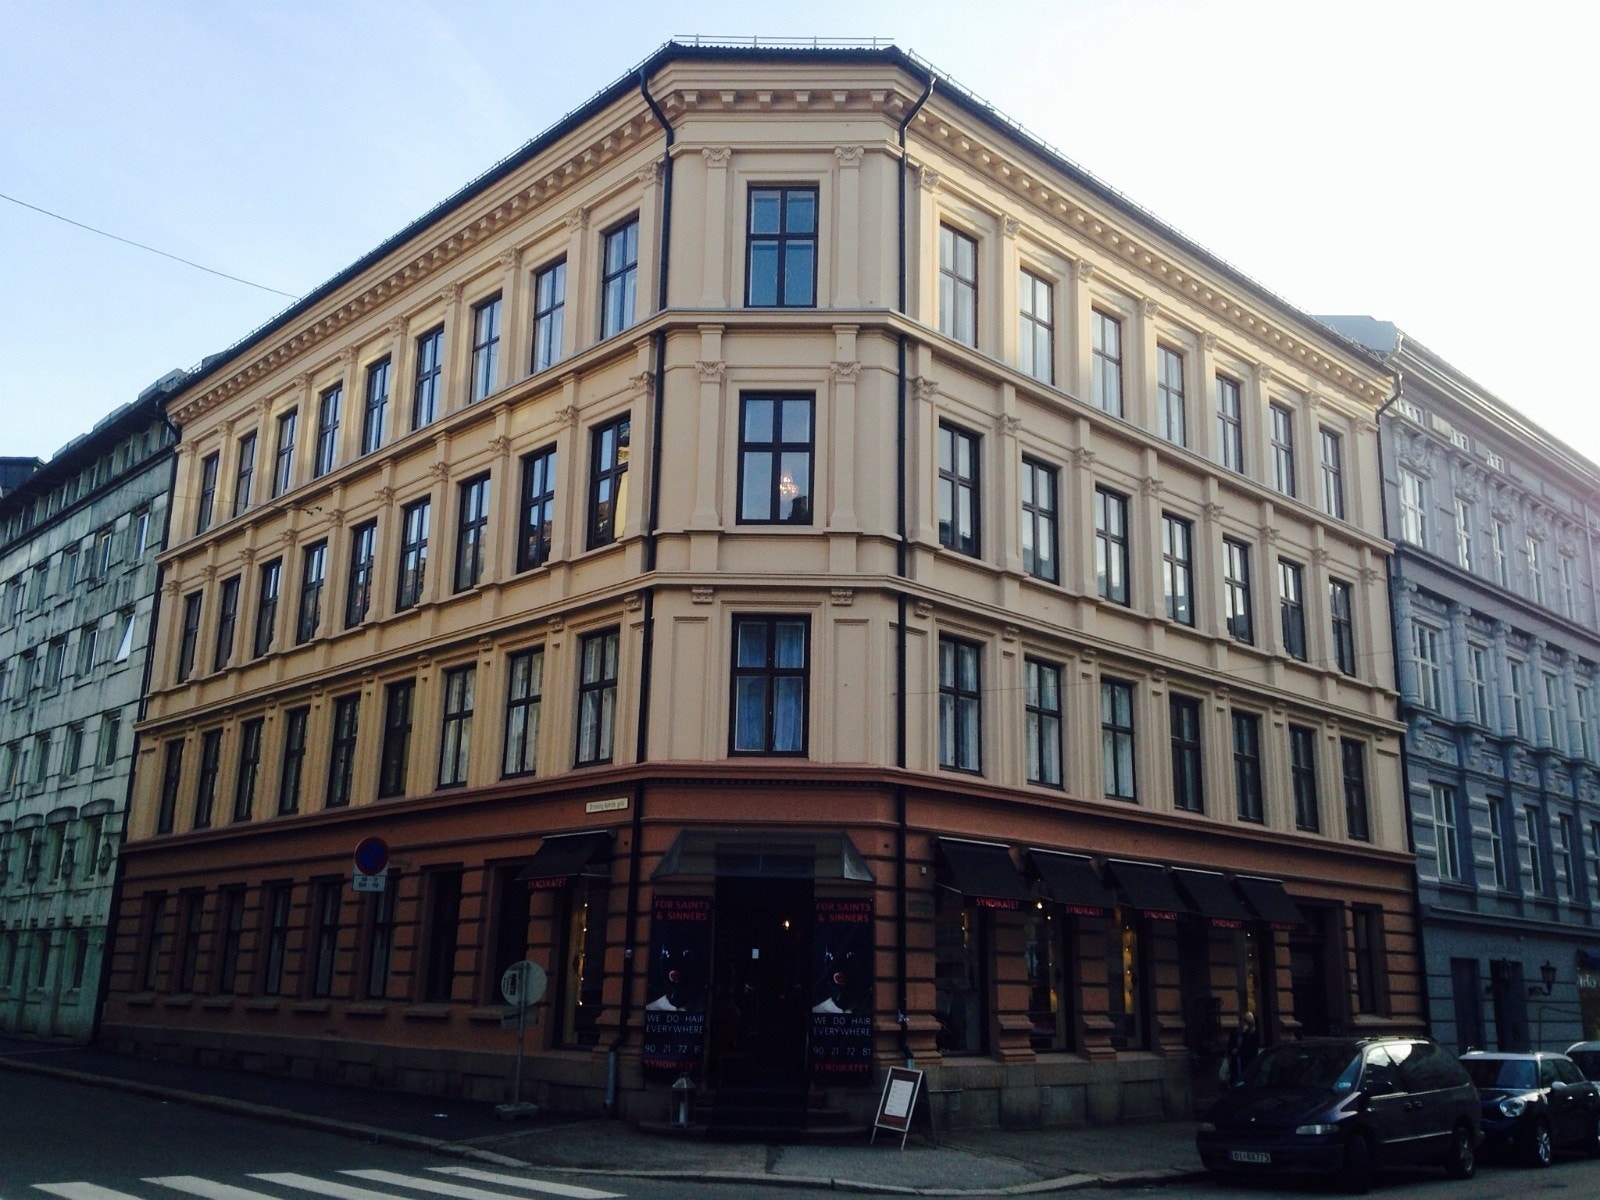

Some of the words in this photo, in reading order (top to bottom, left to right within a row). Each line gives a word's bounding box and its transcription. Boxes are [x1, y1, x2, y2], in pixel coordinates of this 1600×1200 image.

[527, 878, 567, 889] SYNDIKATET
[655, 900, 673, 909] FOR
[676, 901, 711, 910] SAINTS
[816, 902, 834, 911] FOR
[838, 902, 872, 912] SAINTS
[976, 897, 1020, 910] SYNDIKATET
[1065, 904, 1104, 917] SYNDIKATET
[656, 911, 663, 920] &
[667, 911, 708, 921] SINNERS
[817, 913, 825, 922] &
[829, 913, 870, 923] SINNERS
[647, 1014, 660, 1022] WE
[666, 1014, 679, 1023] DO
[685, 1015, 705, 1023] HAIR
[813, 1016, 828, 1025] WE
[833, 1016, 846, 1025] DO
[851, 1017, 872, 1025] HAIR
[646, 1024, 704, 1034] EVERYWHERE
[813, 1026, 871, 1036] EVERYWHERE
[645, 1044, 656, 1053] 90
[662, 1044, 671, 1053] 21
[678, 1045, 687, 1053] 72
[831, 1047, 839, 1056] 21
[847, 1047, 856, 1056] 72
